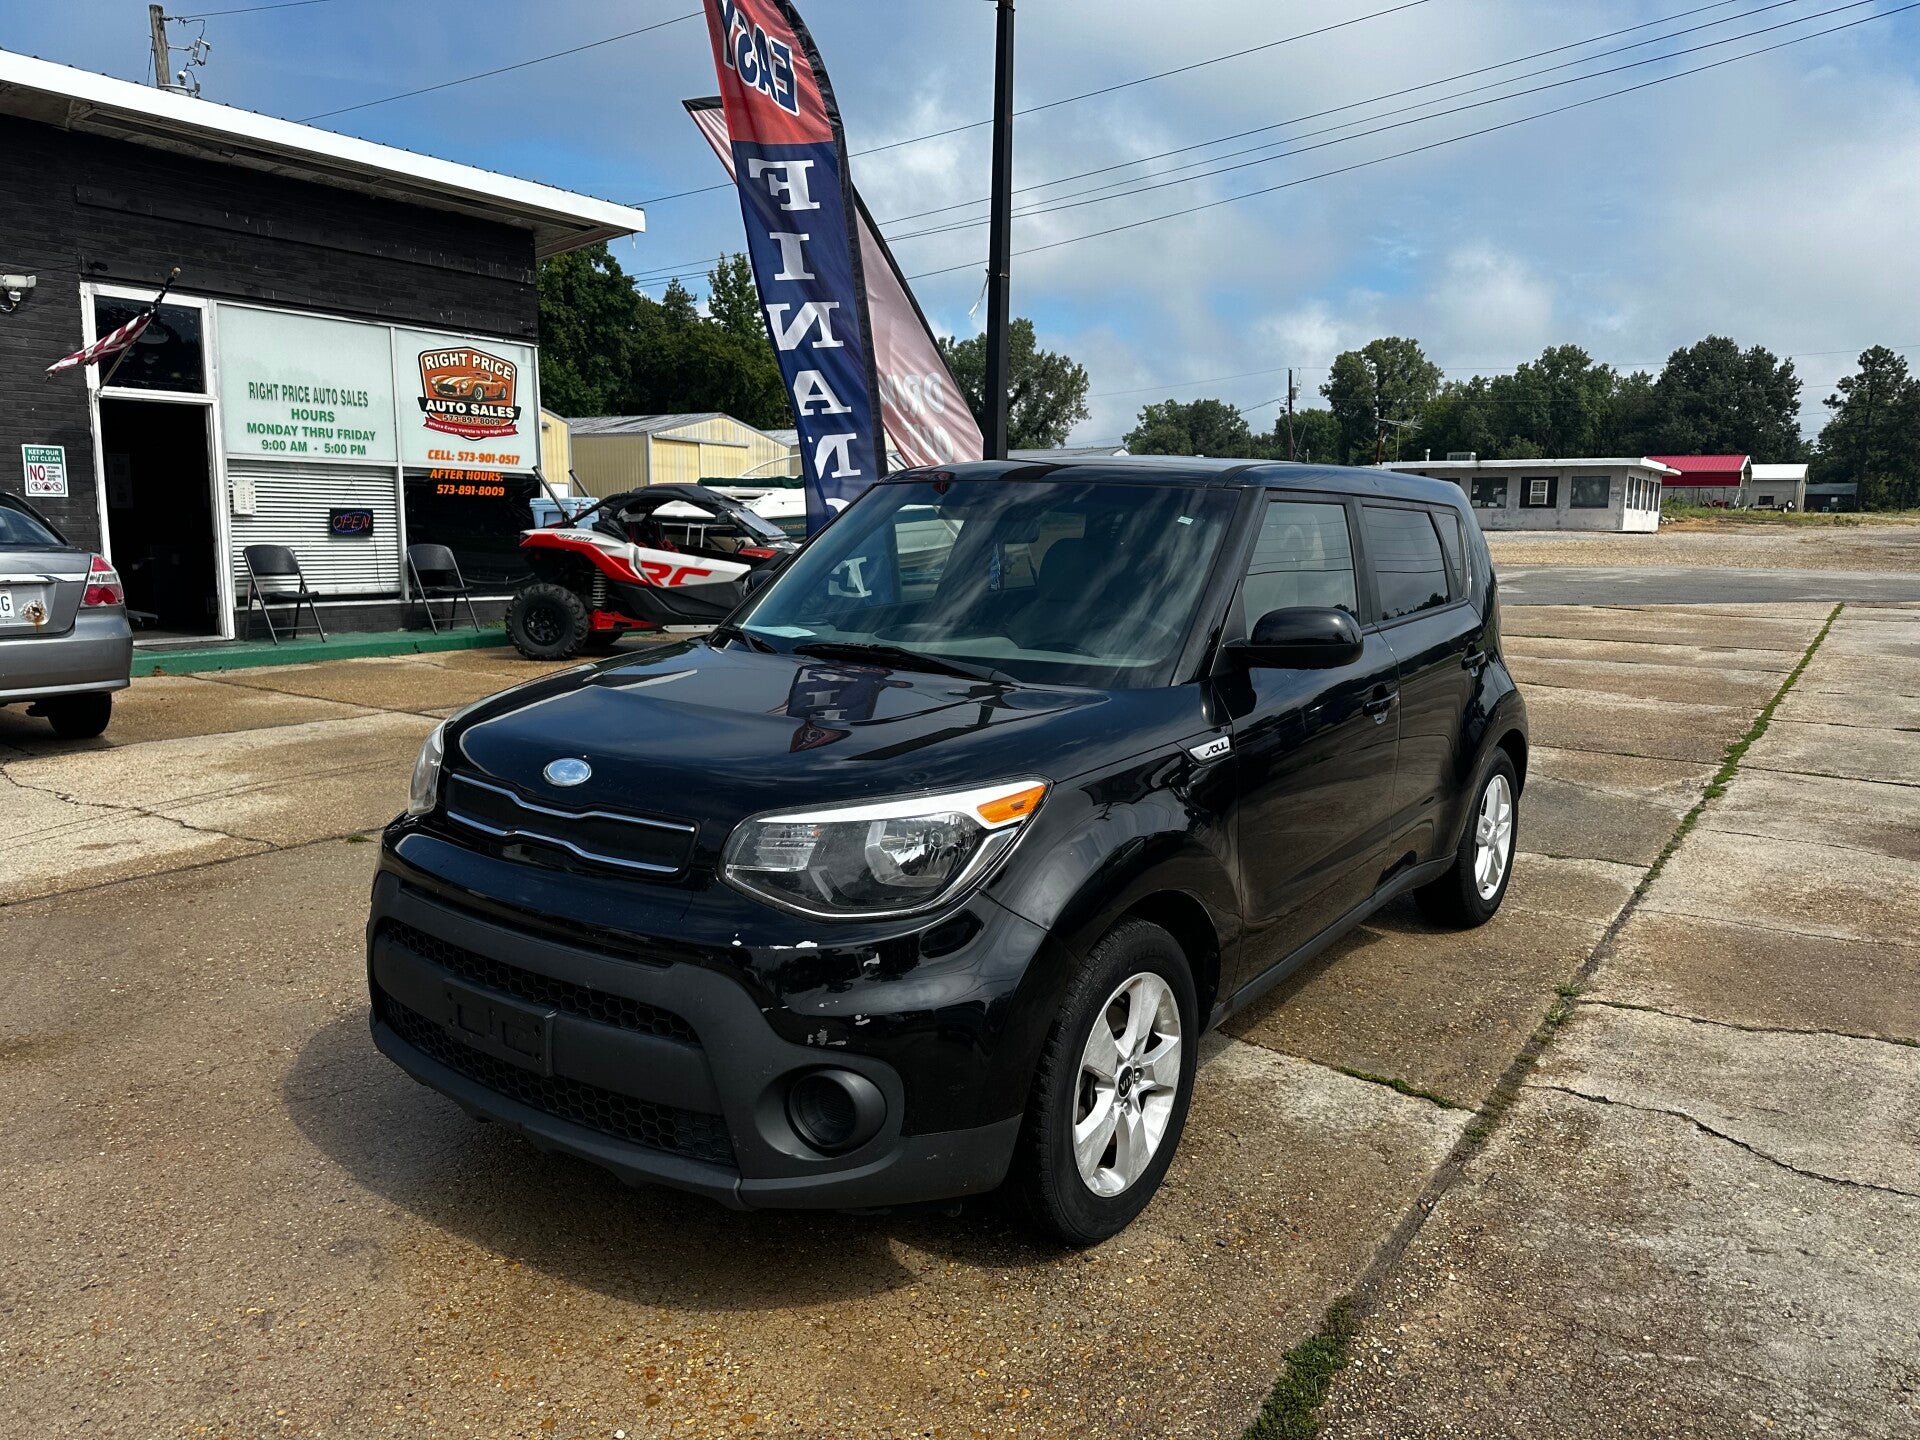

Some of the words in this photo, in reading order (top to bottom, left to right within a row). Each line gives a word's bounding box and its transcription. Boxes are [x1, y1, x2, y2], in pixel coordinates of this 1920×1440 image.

[424, 352, 468, 371] RIGHT
[472, 354, 512, 381] PRICE
[248, 381, 279, 401] RIGHT
[282, 384, 311, 403] PRICE
[313, 387, 339, 406] AUTO
[340, 389, 369, 408] SALES
[291, 408, 336, 423] HOURS
[425, 399, 467, 414] AUTO
[470, 403, 515, 418] SALES
[443, 414, 501, 426] 573-891-8009
[246, 422, 299, 437] MONDAY
[302, 426, 334, 439] THRU
[337, 428, 376, 442] FRIDAY
[261, 439, 287, 452] 9:00
[290, 441, 308, 453] AM
[324, 443, 347, 454] 5:00
[350, 444, 367, 455] PM
[427, 449, 455, 461] CELL:
[457, 451, 521, 466] 573-901-0517
[29, 465, 45, 480] NO
[430, 468, 464, 480] AFTER
[466, 470, 504, 482] HOURS:
[436, 484, 506, 497] 573-891-8009
[333, 515, 370, 528] OPEN
